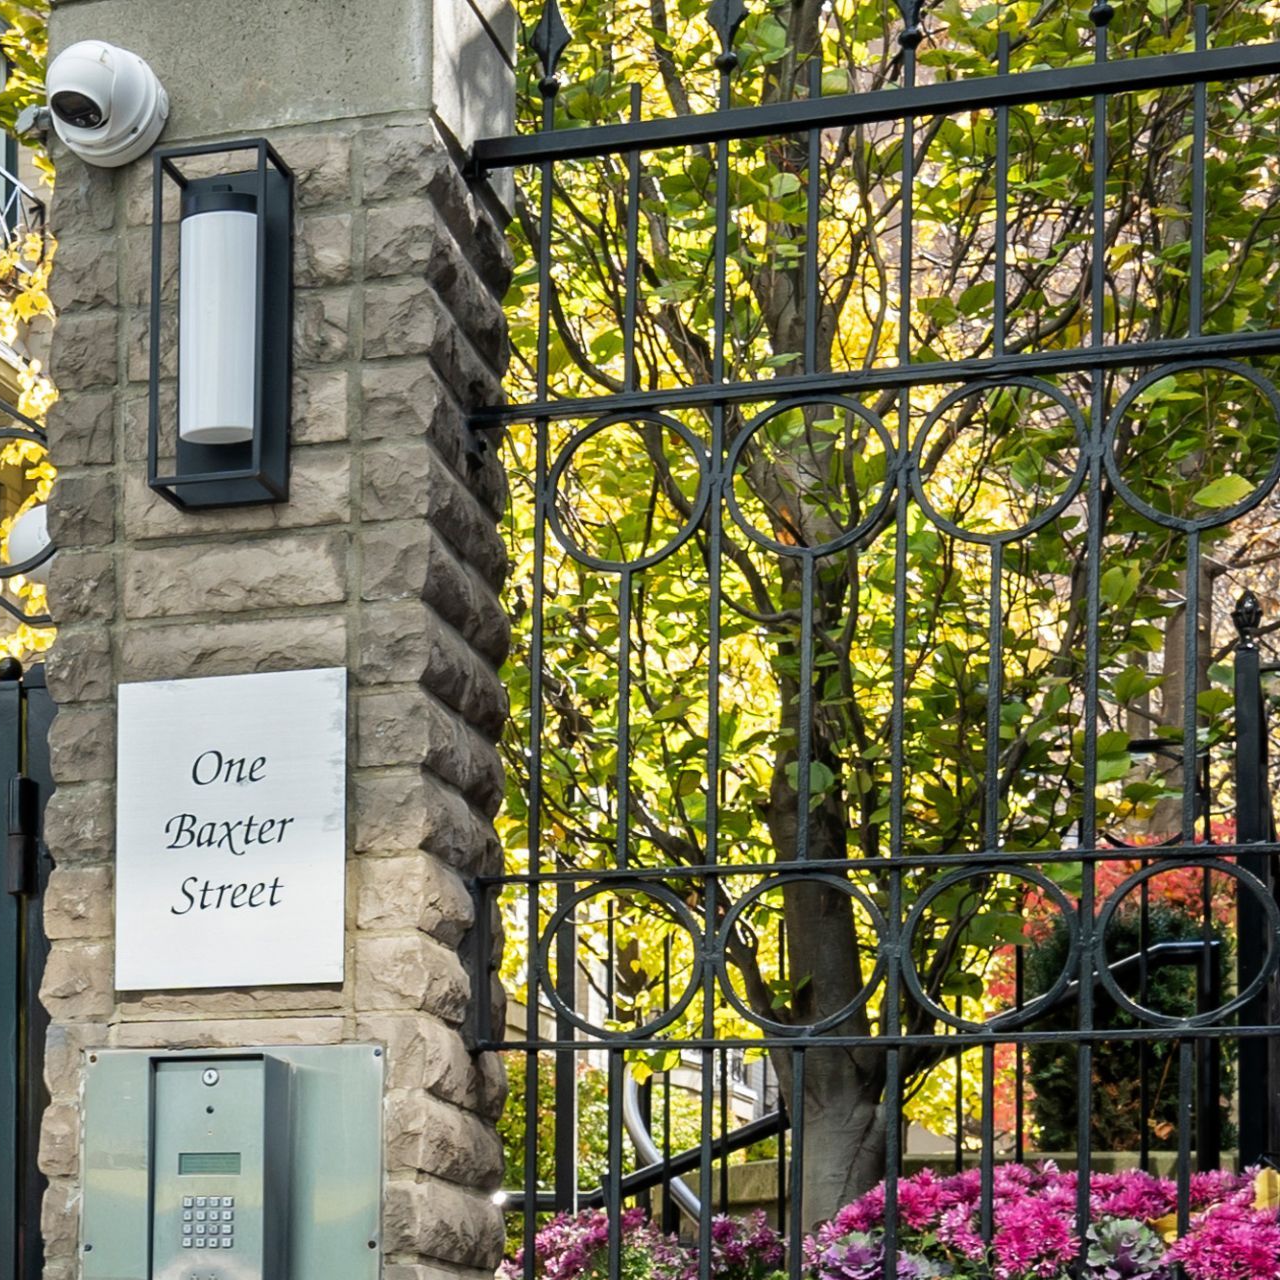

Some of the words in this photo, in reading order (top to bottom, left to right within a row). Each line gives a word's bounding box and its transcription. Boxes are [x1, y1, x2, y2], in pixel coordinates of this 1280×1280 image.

[191, 750, 267, 786] One
[164, 813, 295, 856] Baxter
[170, 876, 285, 915] Street
